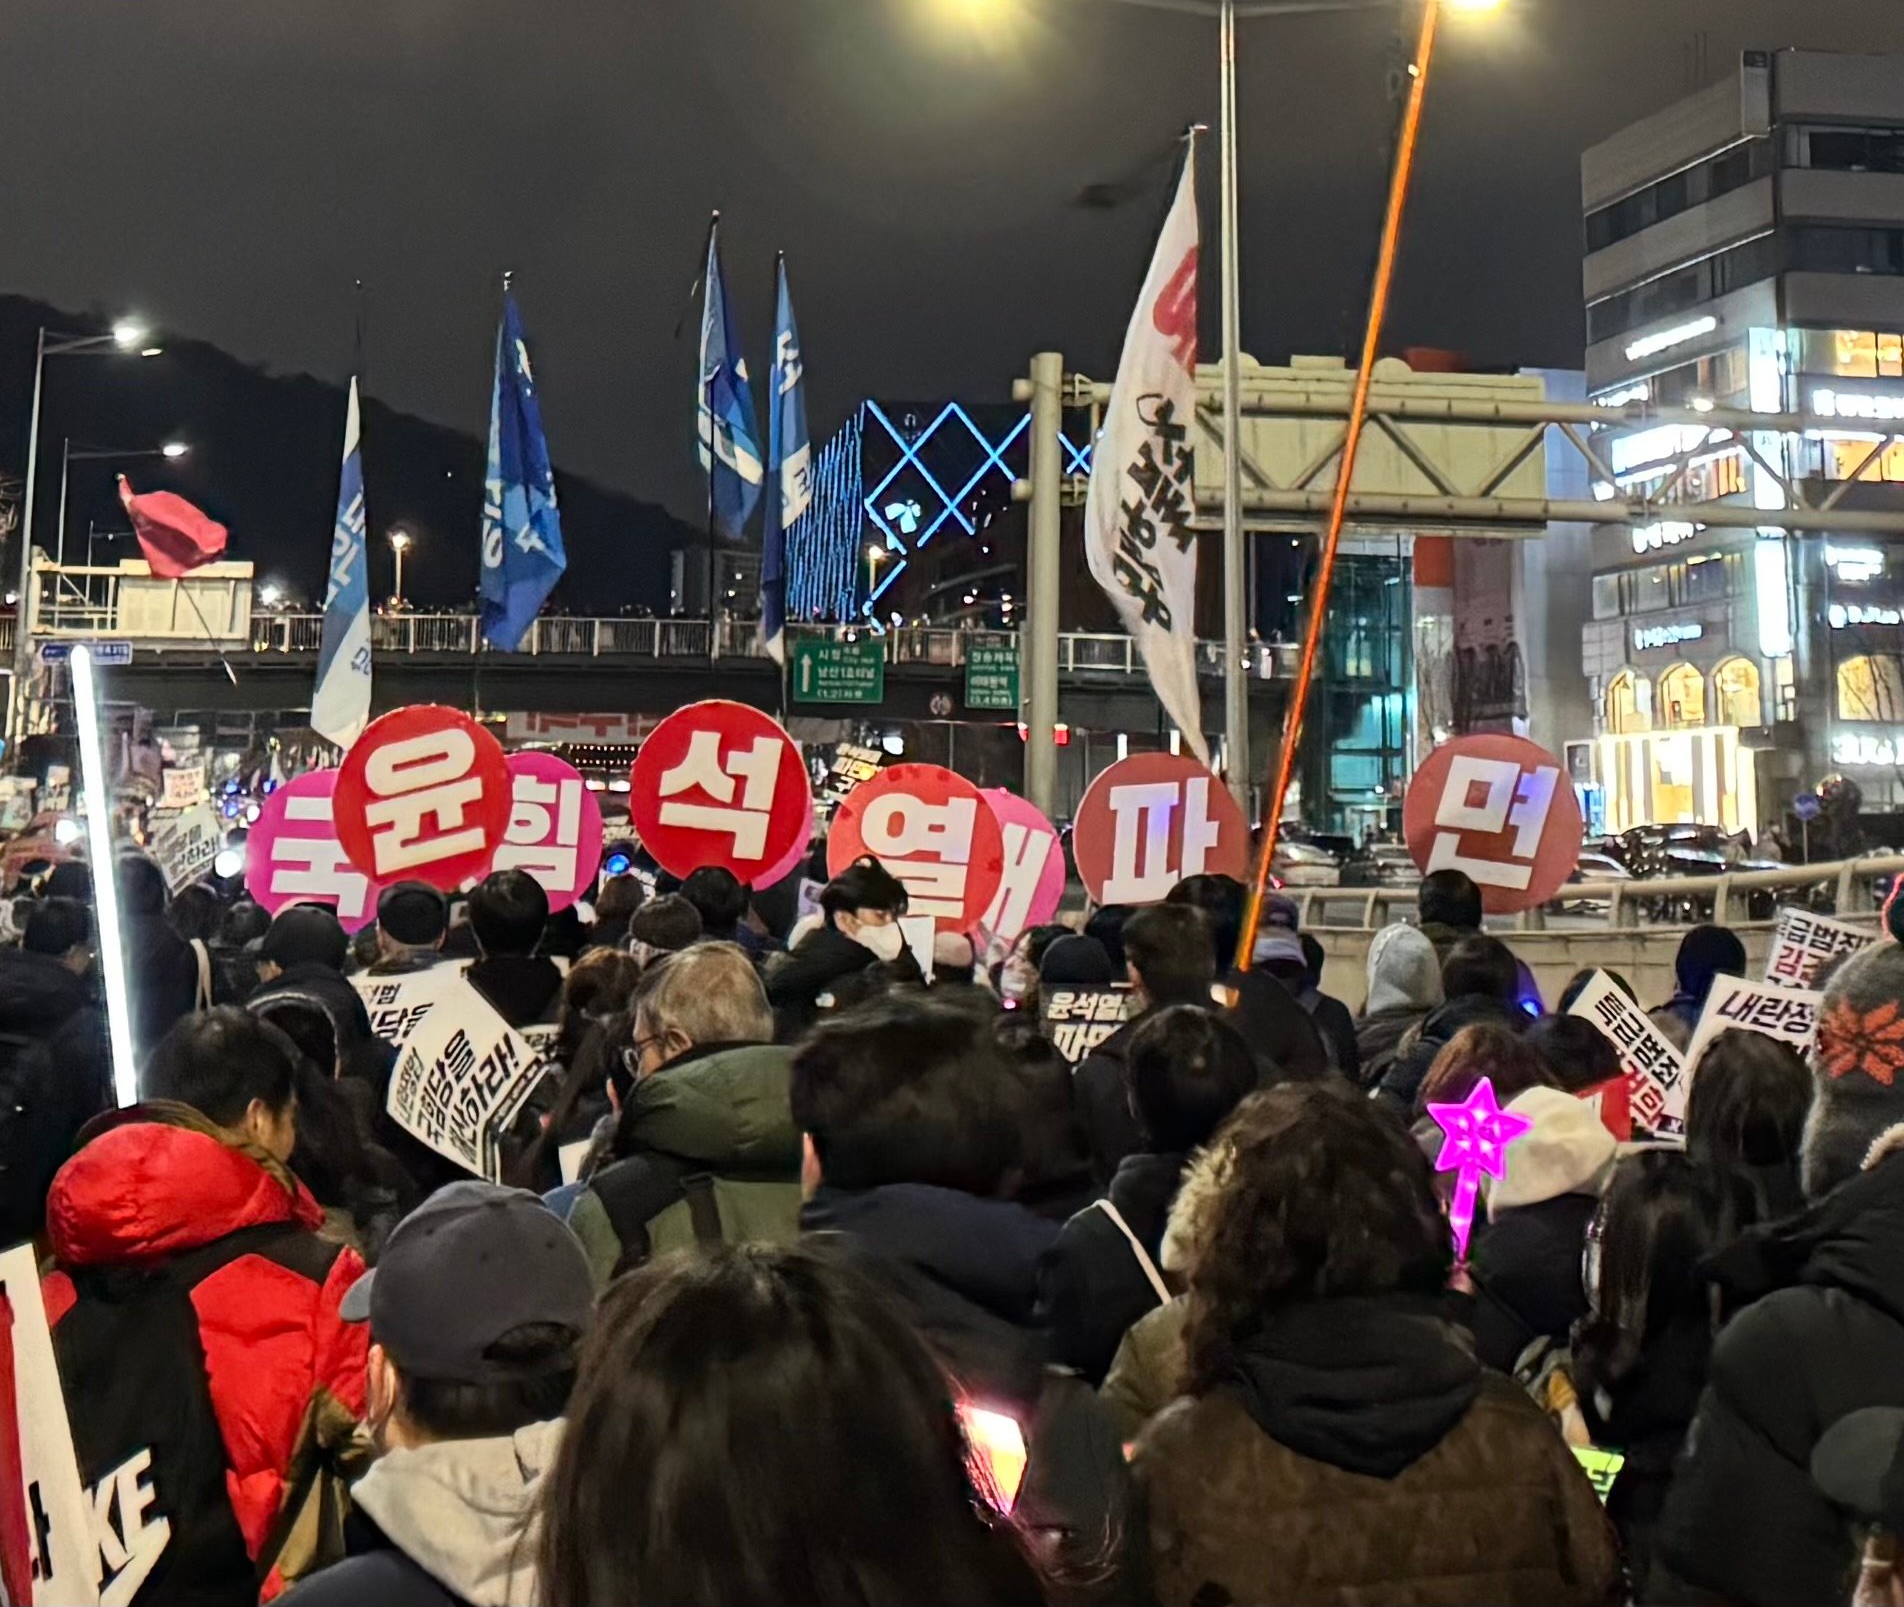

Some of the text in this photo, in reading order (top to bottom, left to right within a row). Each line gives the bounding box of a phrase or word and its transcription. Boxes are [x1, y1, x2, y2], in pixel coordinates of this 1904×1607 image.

[363, 726, 486, 877] 윤
[658, 730, 784, 861] 석
[861, 792, 977, 918] 열
[1102, 778, 1219, 905] 파
[1426, 755, 1560, 891] 면
[1778, 915, 1875, 955] 급범죄
[416, 1028, 477, 1147] 국힘당을
[448, 1031, 520, 1167] 해산하라!
